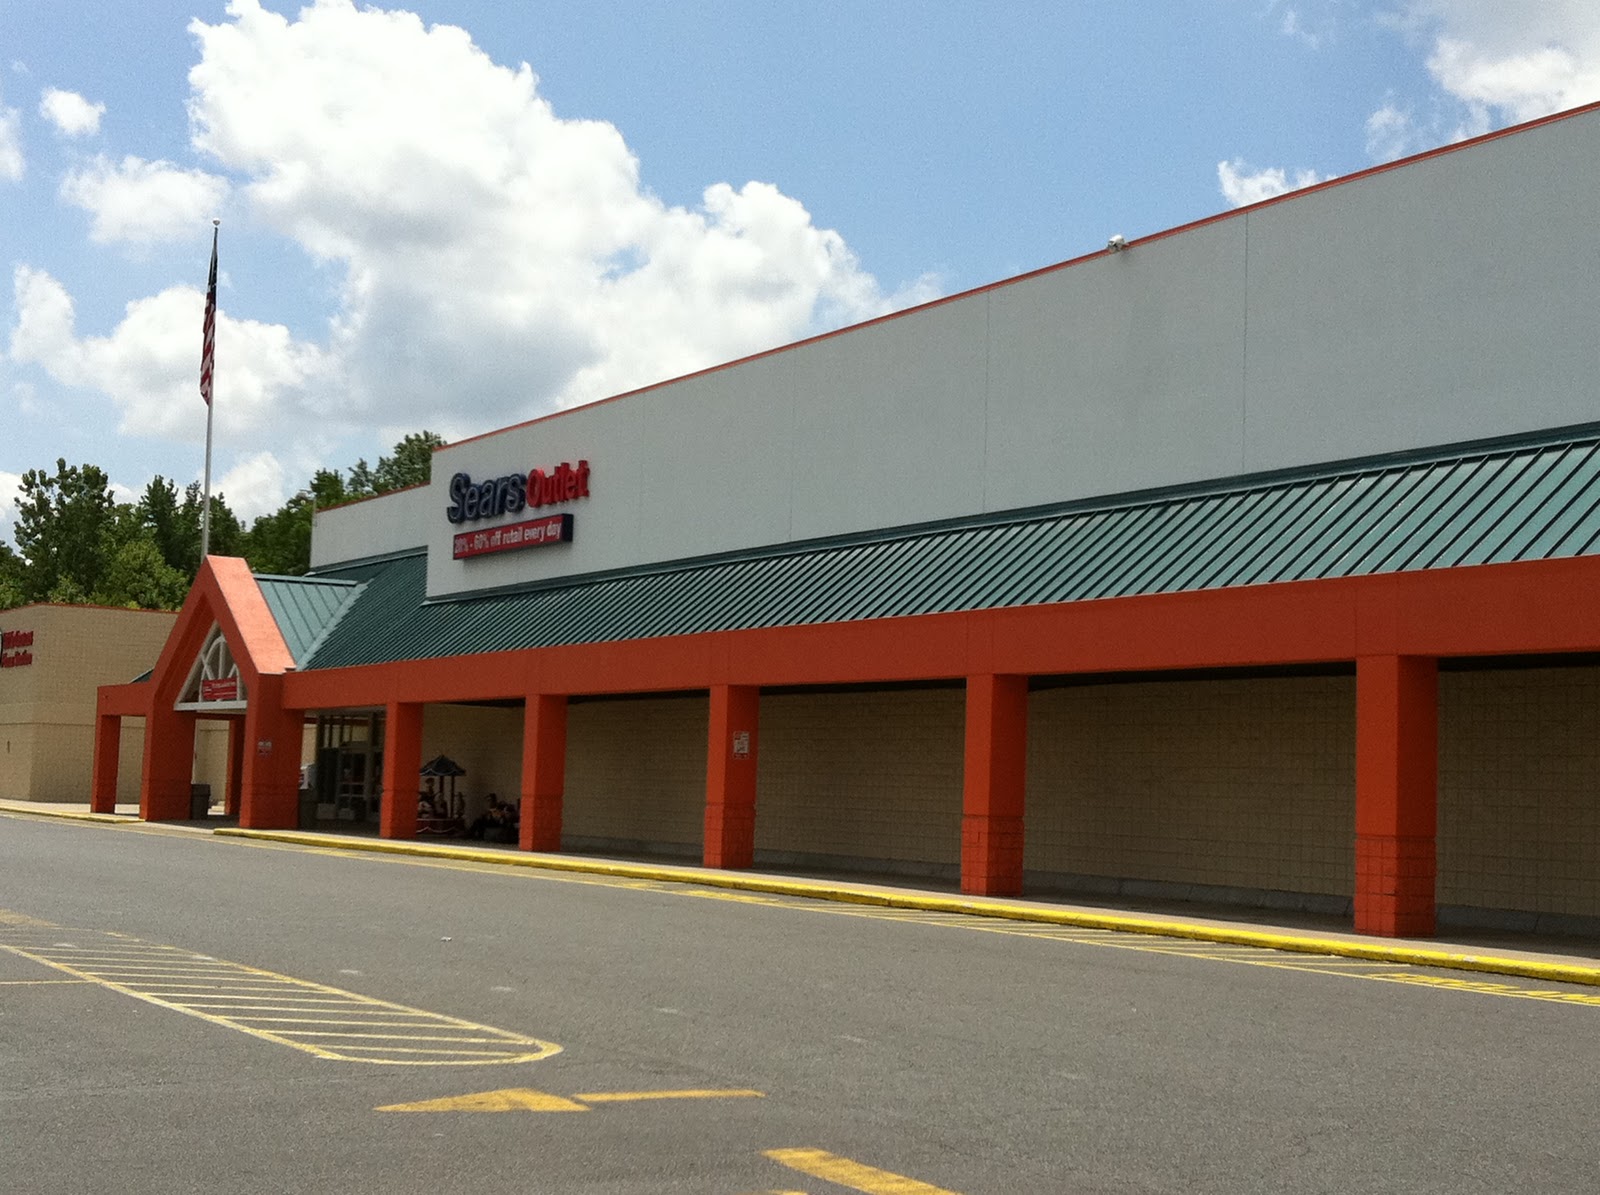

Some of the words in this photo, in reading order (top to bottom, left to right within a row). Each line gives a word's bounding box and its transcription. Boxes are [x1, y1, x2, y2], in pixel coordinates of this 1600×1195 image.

[447, 473, 527, 524] Sears
[526, 460, 590, 508] Outlet
[490, 529, 502, 547] off
[502, 526, 523, 544] retail
[524, 525, 546, 542] every
[546, 520, 562, 539] day
